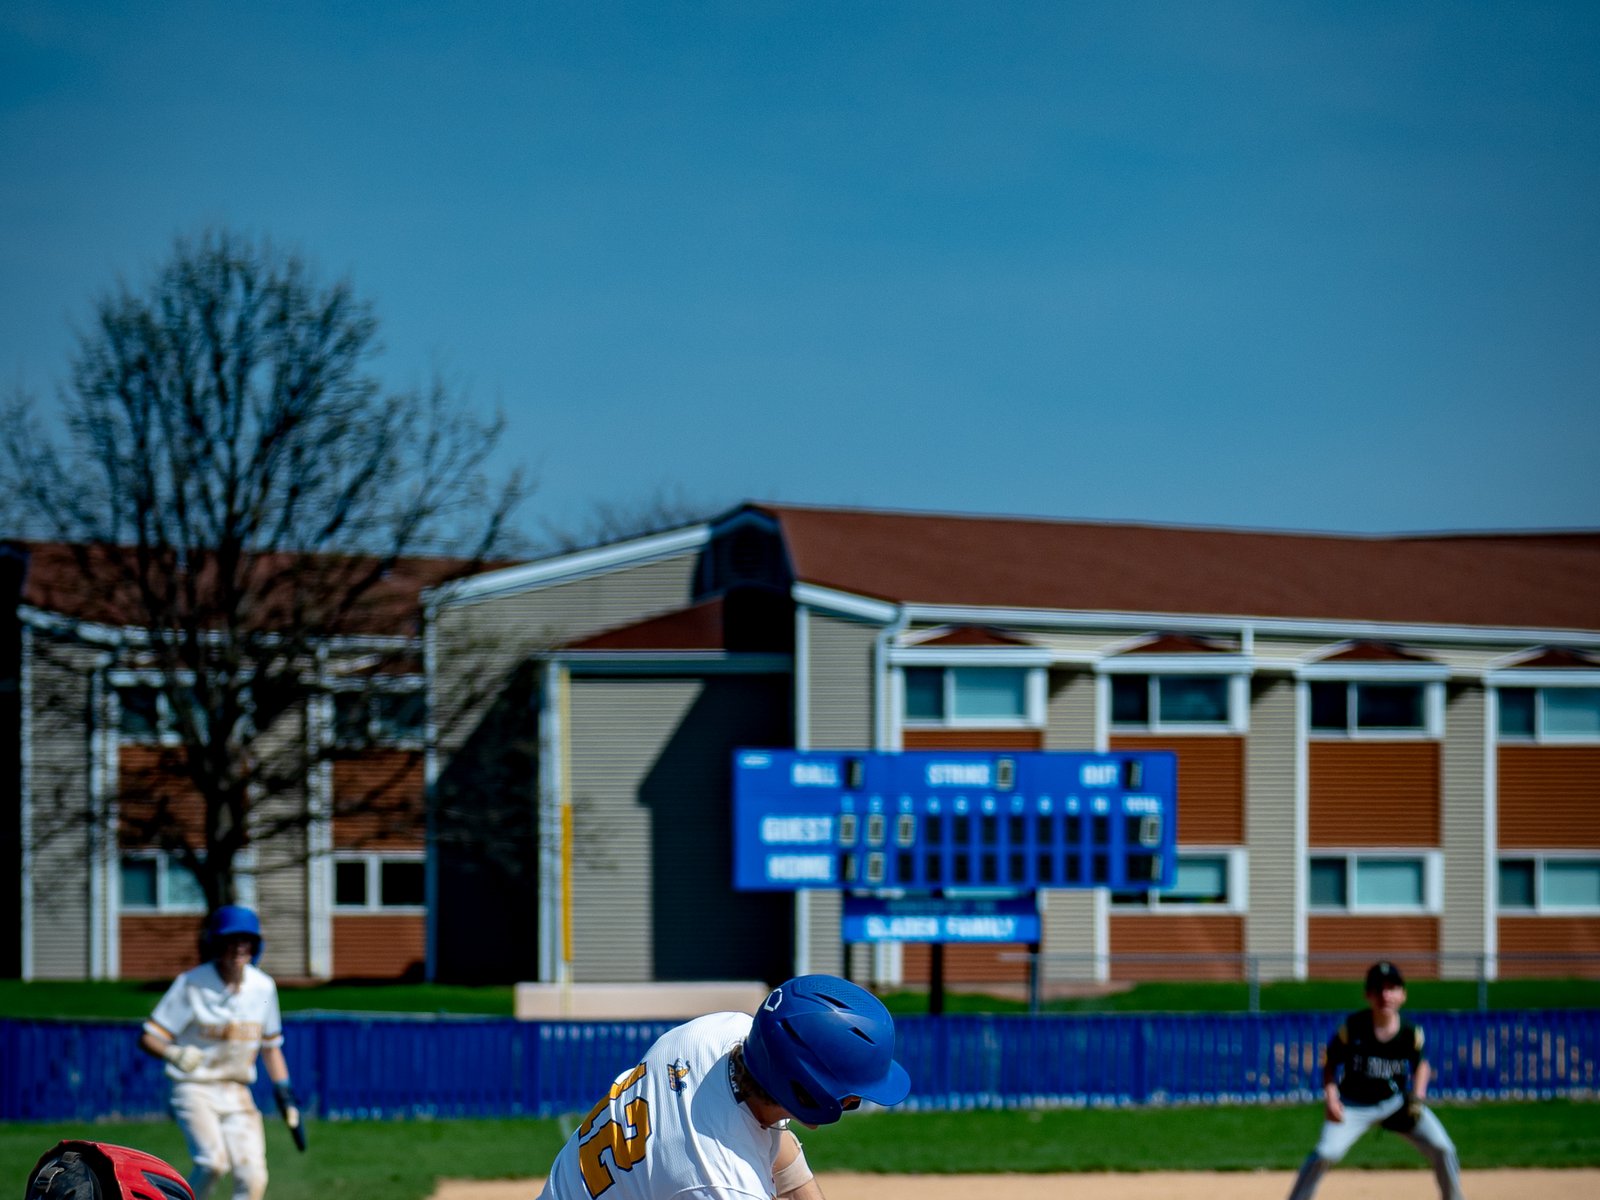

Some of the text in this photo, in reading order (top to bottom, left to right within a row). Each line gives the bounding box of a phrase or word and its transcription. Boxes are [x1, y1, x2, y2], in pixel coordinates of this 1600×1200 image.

[793, 764, 836, 784] BALL
[928, 764, 990, 785] STRIKE
[1082, 764, 1118, 785] OUT
[762, 817, 832, 842] GUEST
[768, 854, 831, 880] HOME
[946, 917, 1014, 937] FAMILY
[578, 1061, 652, 1200] 12
